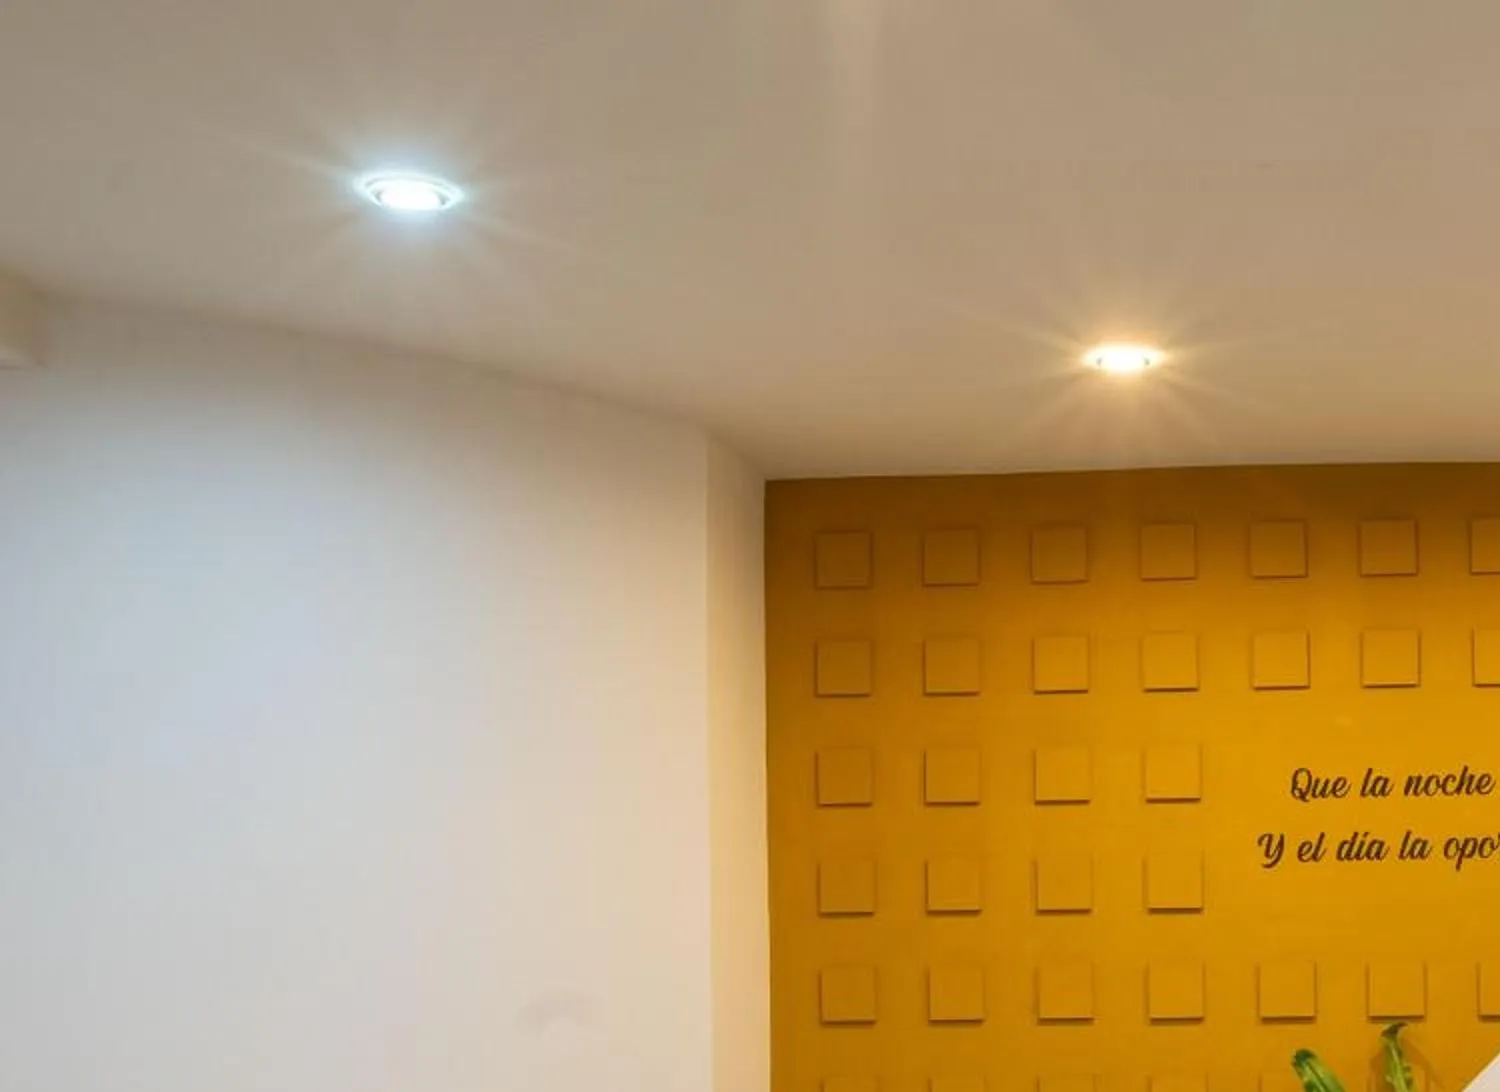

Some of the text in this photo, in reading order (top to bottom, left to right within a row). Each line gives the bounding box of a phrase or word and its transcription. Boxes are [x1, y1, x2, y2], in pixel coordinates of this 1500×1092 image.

[1290, 767, 1351, 803] Que
[1360, 767, 1393, 798] la
[1403, 765, 1496, 797] noche
[1257, 832, 1286, 869] Y
[1296, 832, 1327, 863] el
[1336, 831, 1391, 862] día
[1399, 829, 1433, 861] la
